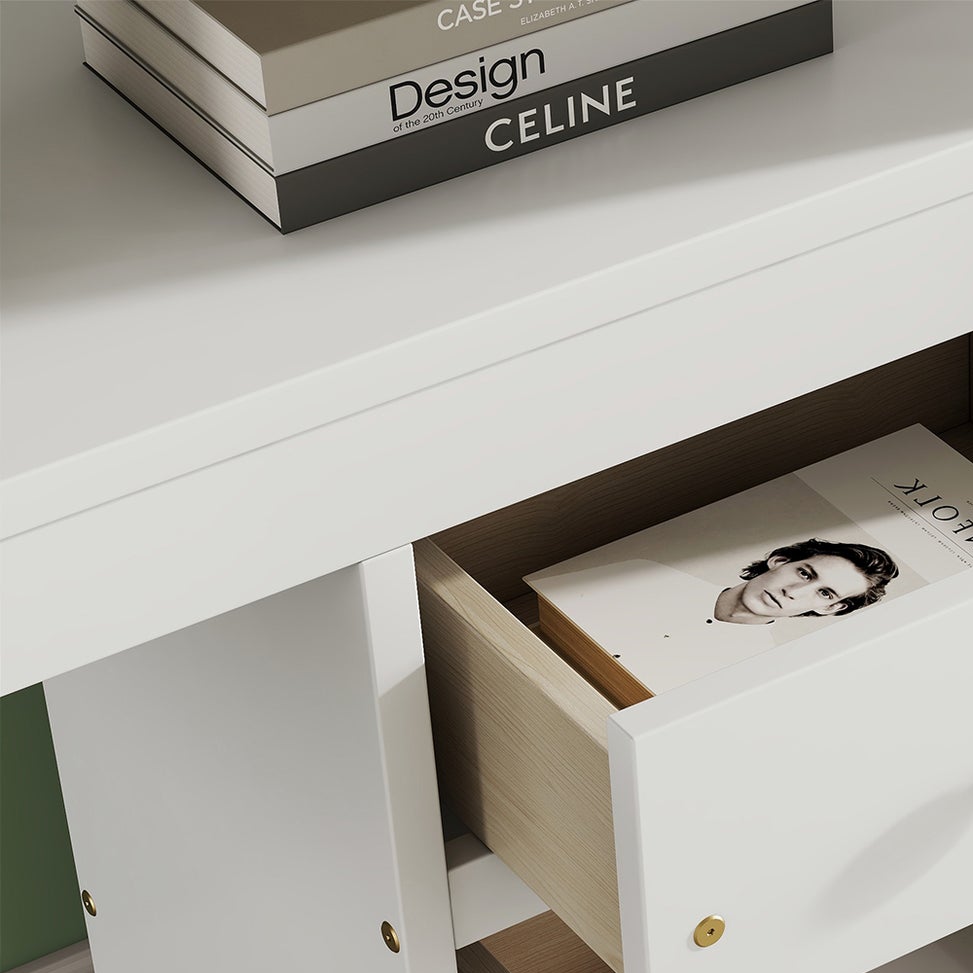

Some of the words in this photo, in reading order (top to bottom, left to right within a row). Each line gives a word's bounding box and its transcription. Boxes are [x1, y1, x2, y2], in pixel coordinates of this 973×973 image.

[437, 0, 502, 31] CASE
[520, 6, 567, 25] ELIZABETH
[389, 48, 546, 121] Design
[392, 122, 403, 132] of
[405, 118, 421, 129] the
[423, 110, 444, 123] 20th
[446, 98, 484, 115] Century
[484, 76, 638, 152] CELINE
